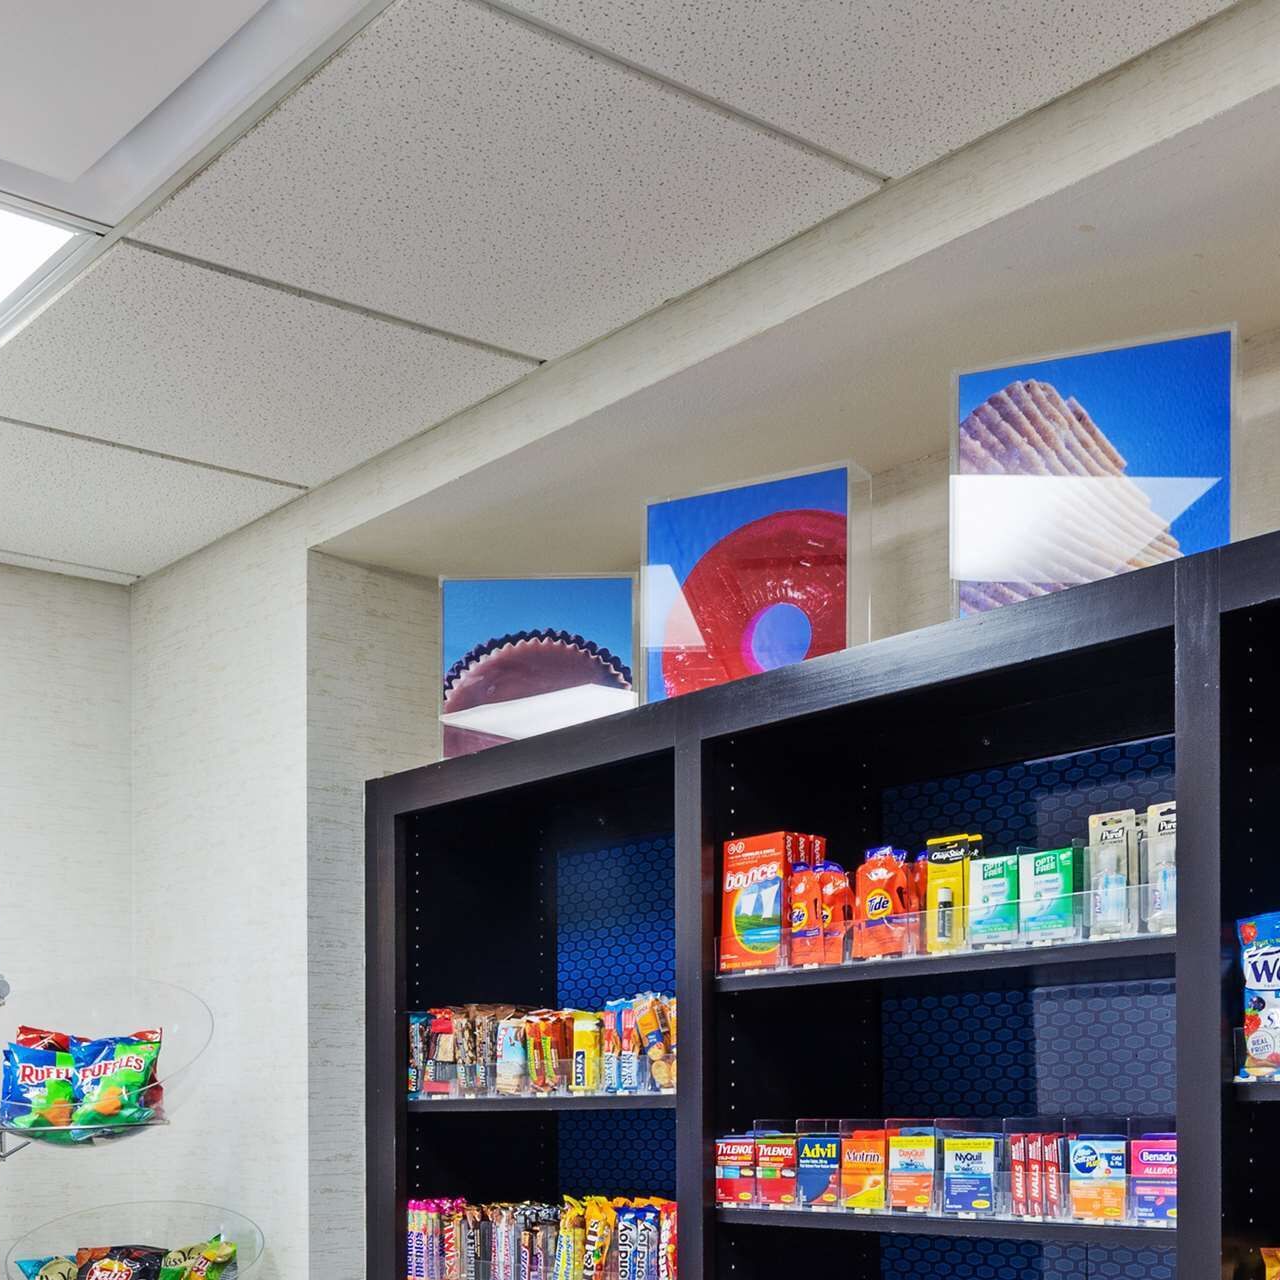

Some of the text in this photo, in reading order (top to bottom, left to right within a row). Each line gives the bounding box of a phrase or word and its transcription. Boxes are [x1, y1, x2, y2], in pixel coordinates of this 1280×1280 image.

[983, 869, 1004, 879] FREE
[1035, 863, 1056, 874] FREE
[725, 862, 780, 893] bounce
[868, 897, 889, 913] Tide
[19, 1064, 72, 1085] RUFFL
[410, 1068, 418, 1091] KIND
[717, 1143, 753, 1155] TYLENOL
[758, 1144, 793, 1156] TYLENOL
[800, 1143, 837, 1158] Advil
[846, 1150, 881, 1162] Motrin
[954, 1152, 982, 1163] NyQuil
[1143, 1152, 1177, 1163] Benadry
[1015, 1164, 1024, 1199] HALLS
[1031, 1164, 1040, 1198] HALLS
[1048, 1165, 1058, 1200] HALLS
[415, 1231, 424, 1278] mentos
